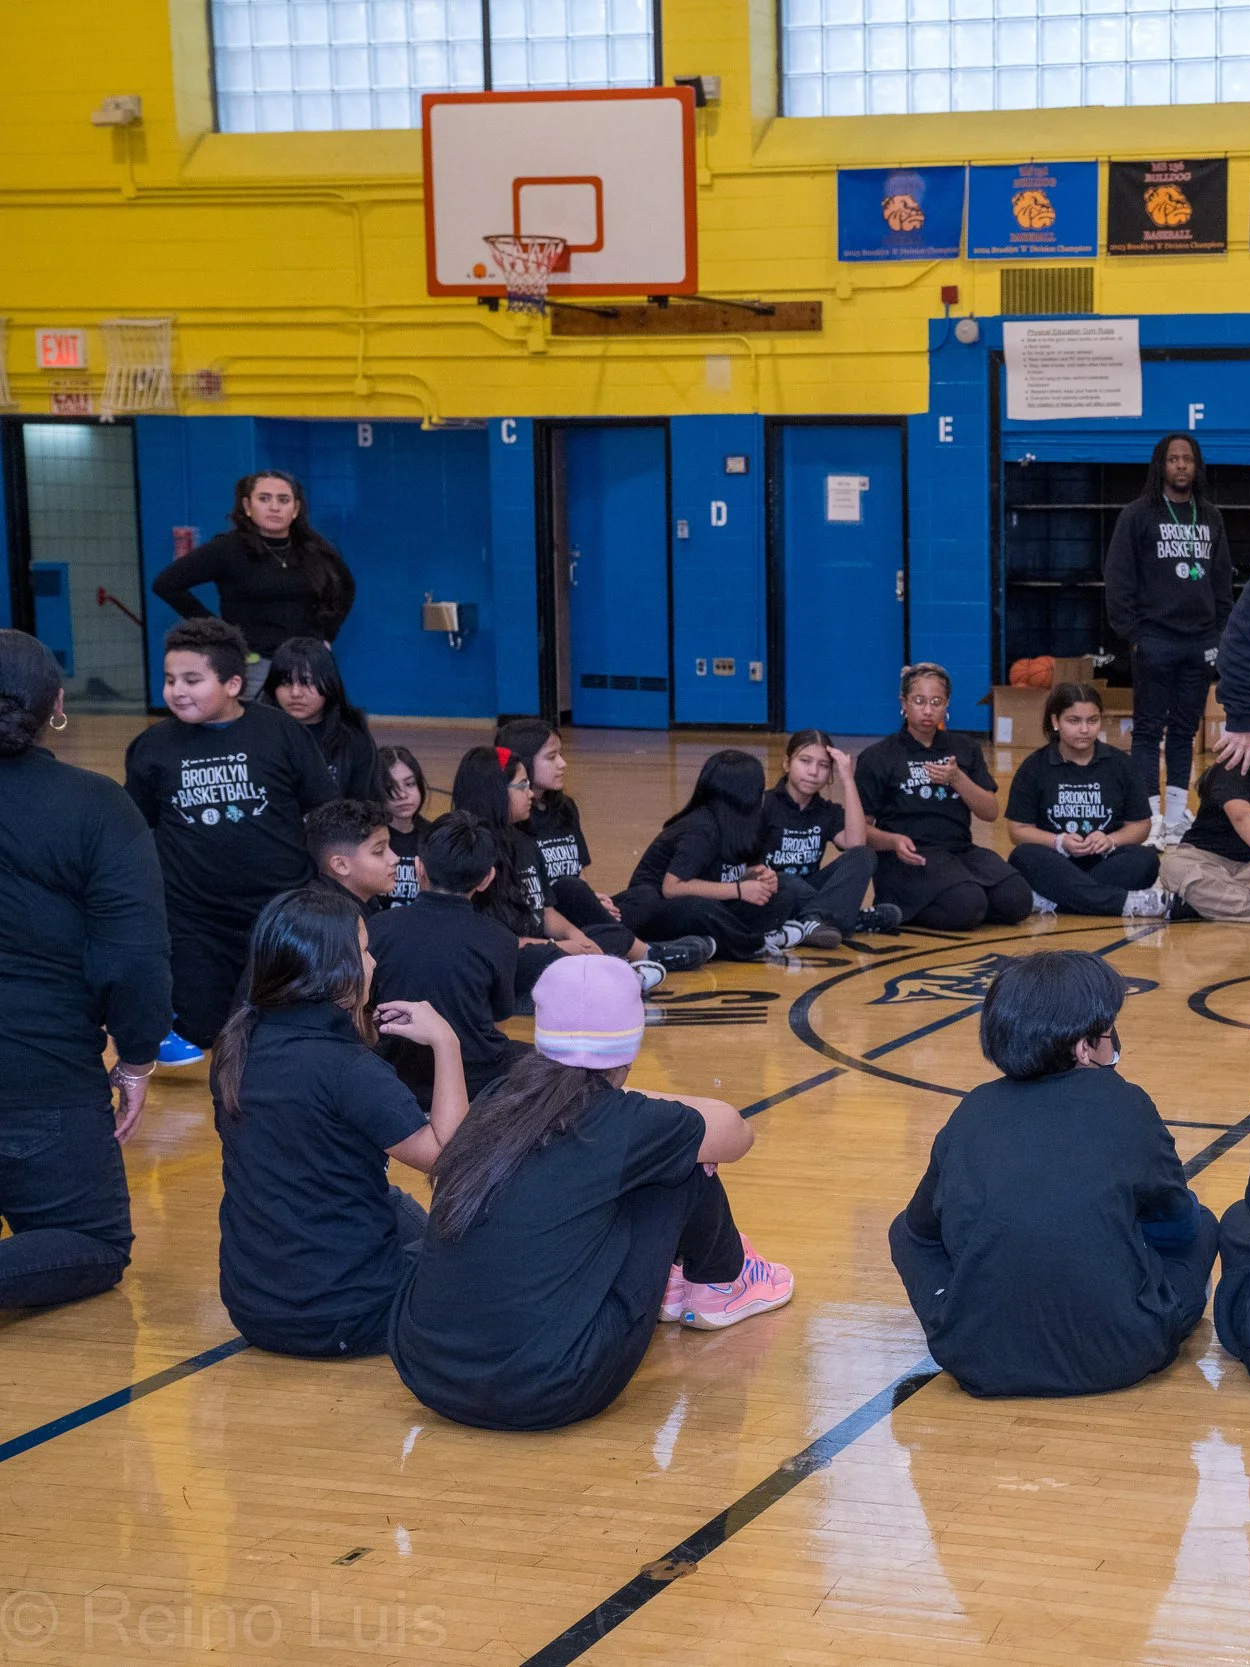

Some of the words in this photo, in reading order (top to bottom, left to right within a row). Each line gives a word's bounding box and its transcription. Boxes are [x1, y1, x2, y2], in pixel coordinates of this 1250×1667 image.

[42, 335, 79, 367] EXIT
[1188, 403, 1205, 430] F
[357, 423, 373, 447] B
[501, 419, 517, 444] C
[938, 416, 953, 442] E
[710, 501, 728, 527] D
[1159, 523, 1210, 541] BROOKLYN
[1157, 541, 1212, 559] BASKETBALL
[182, 764, 248, 788] BROOKLYN
[177, 782, 260, 808] BASKETBALL
[1058, 791, 1101, 805] BROOKLYN
[1053, 805, 1106, 818] BASKETBALL
[781, 836, 820, 852] BROOKLYN
